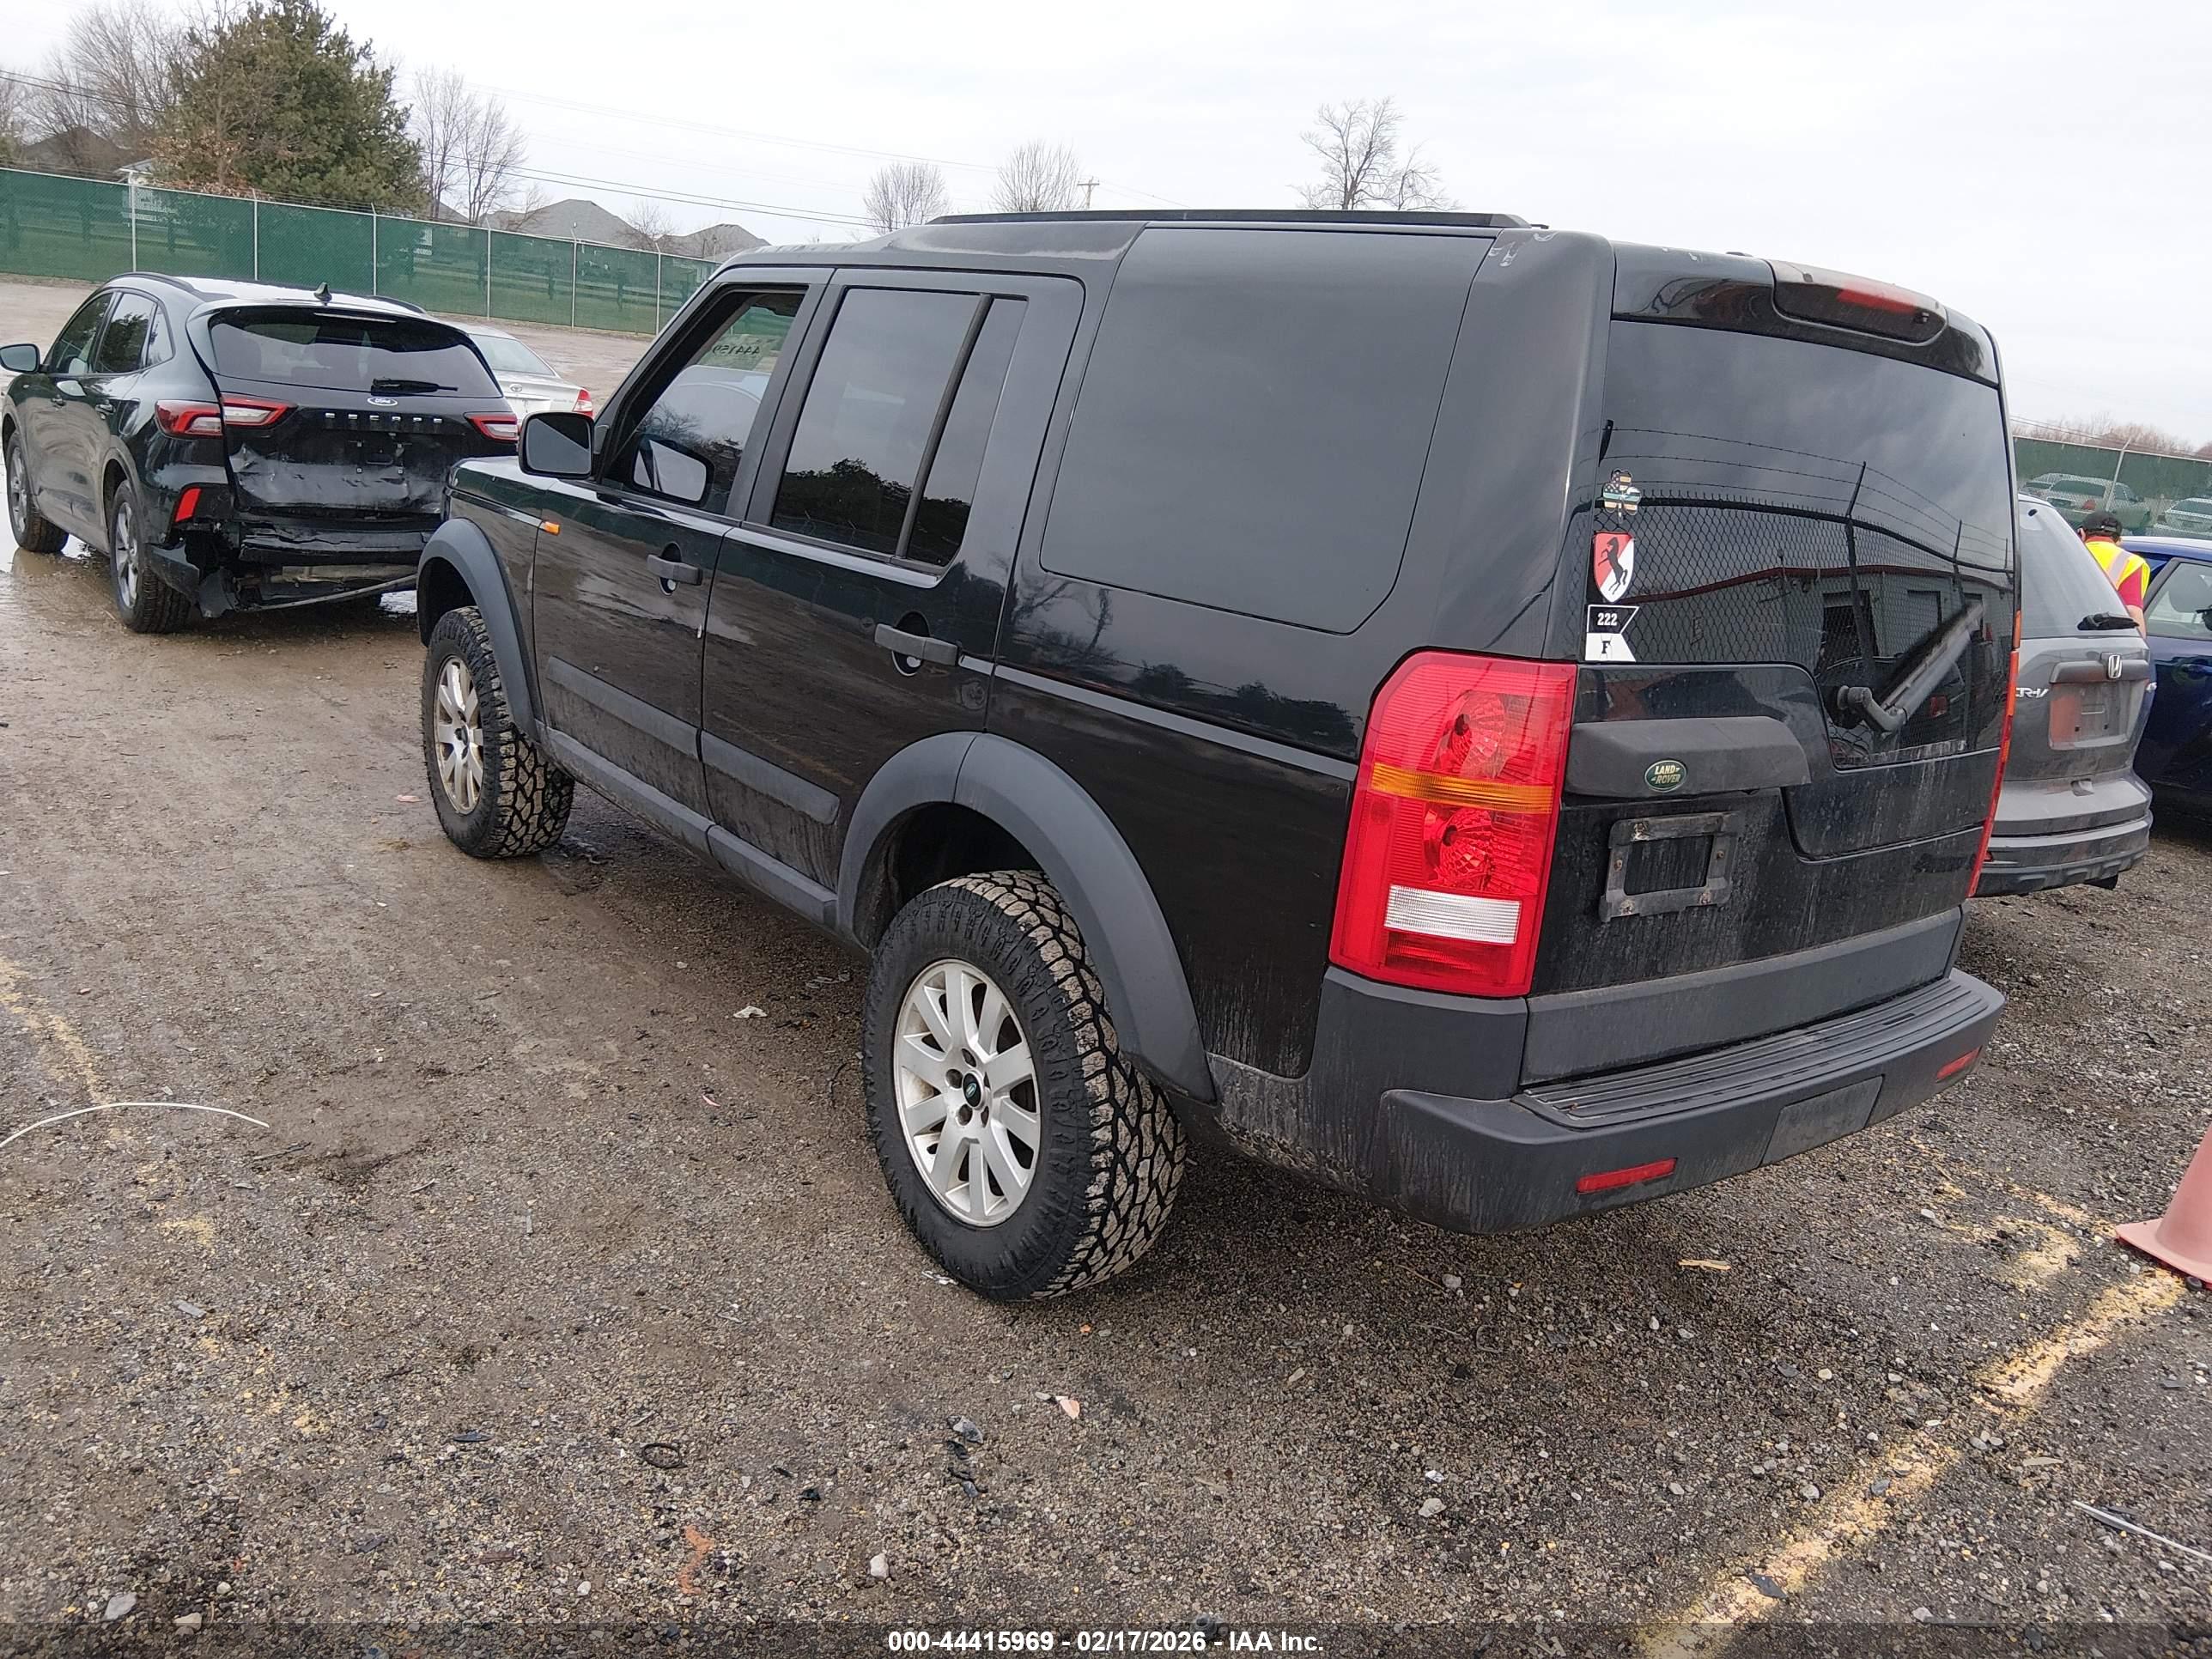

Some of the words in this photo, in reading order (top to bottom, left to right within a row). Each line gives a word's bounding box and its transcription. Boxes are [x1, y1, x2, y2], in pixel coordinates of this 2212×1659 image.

[325, 412, 443, 424] ESCAPE
[1597, 612, 1618, 626] 222
[1601, 641, 1611, 654] F
[1654, 764, 1676, 775] LAND
[1655, 774, 1681, 785] ROVER
